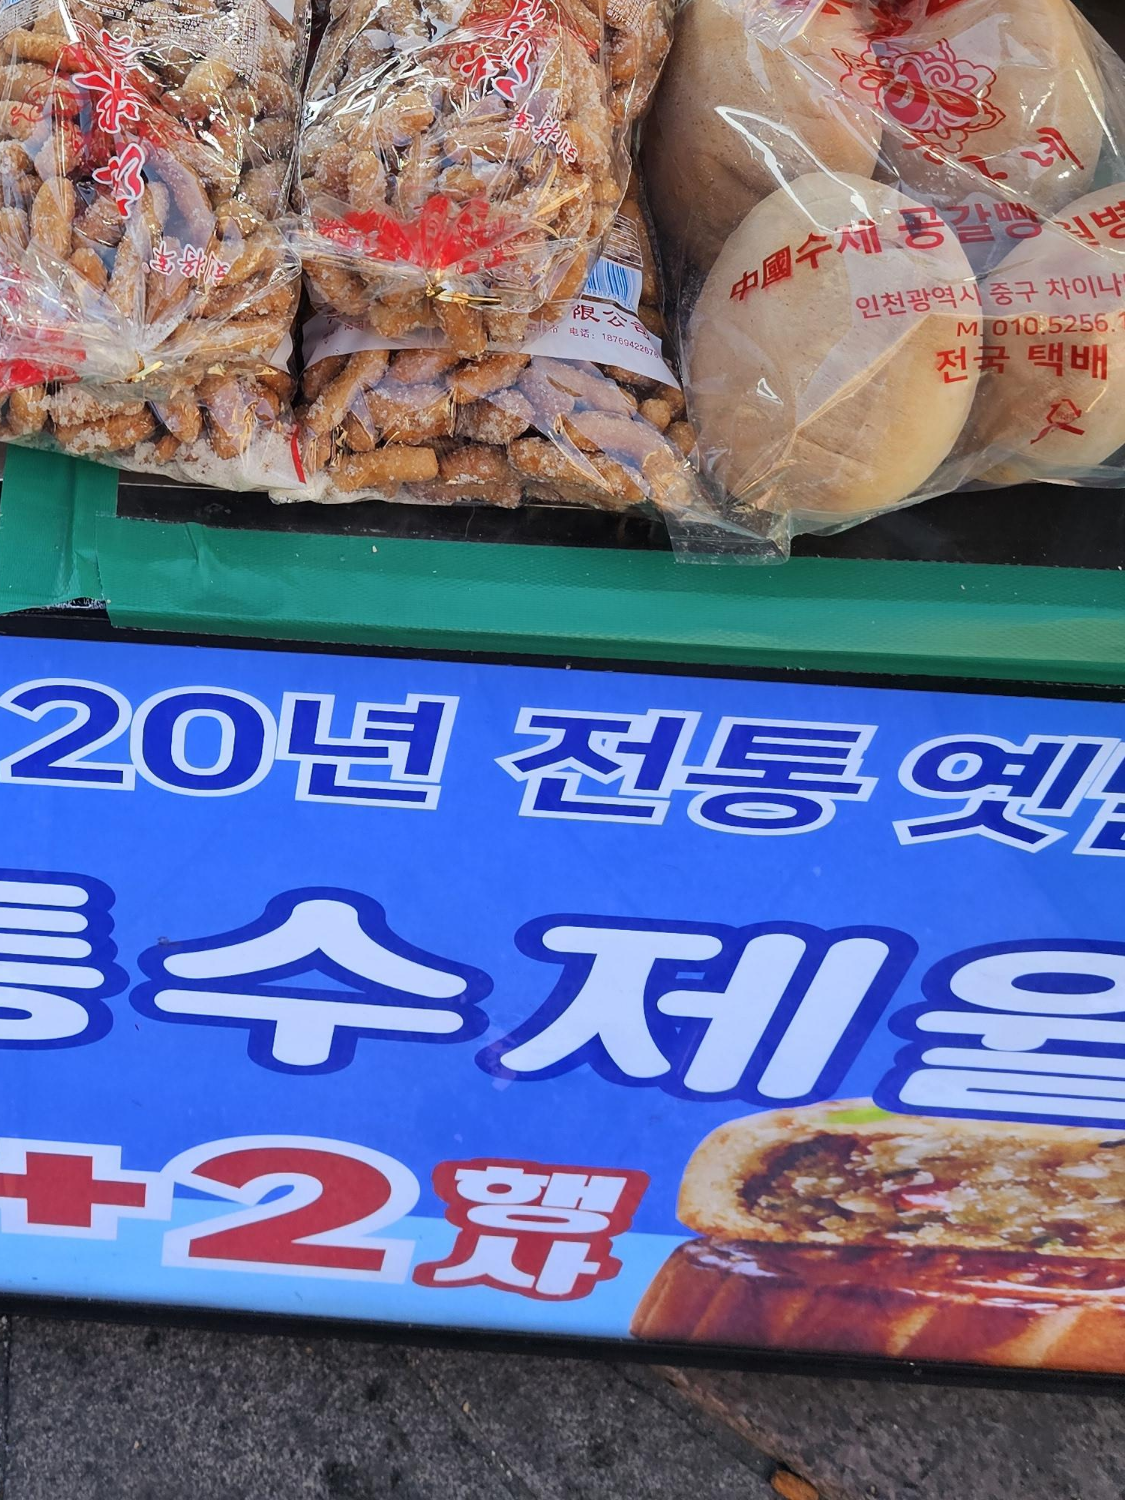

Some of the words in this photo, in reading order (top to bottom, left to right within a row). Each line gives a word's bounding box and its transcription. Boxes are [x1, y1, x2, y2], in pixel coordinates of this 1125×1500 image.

[897, 201, 1044, 250] 공갈빵
[855, 283, 983, 320] 인천광역시
[989, 279, 1040, 308] 중구
[1045, 272, 1125, 301] 차이나
[936, 344, 1011, 385] 전국
[1026, 341, 1108, 380] 택배
[494, 705, 880, 837] 전통
[423, 1160, 639, 1300] 행사
